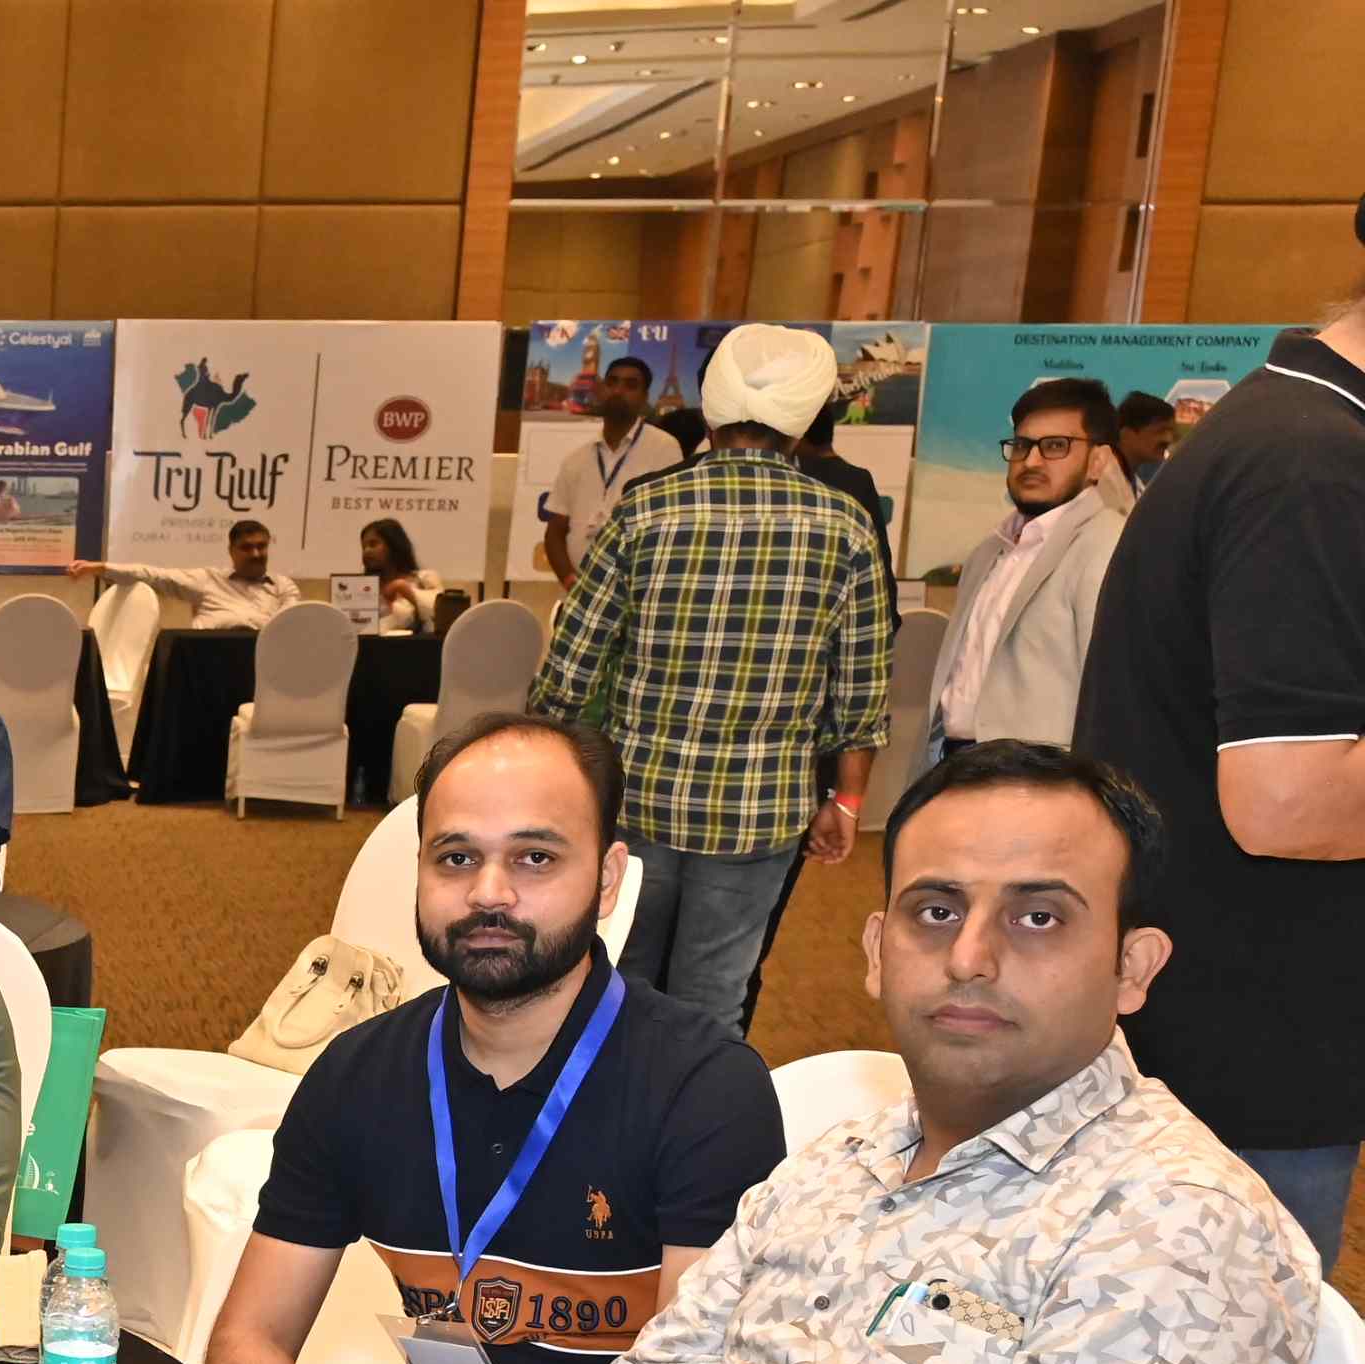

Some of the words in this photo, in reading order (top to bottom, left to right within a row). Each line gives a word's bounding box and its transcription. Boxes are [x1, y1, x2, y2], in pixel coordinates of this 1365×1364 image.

[8, 331, 73, 348] Celestyal
[1014, 334, 1097, 346] DESTINATION
[1101, 335, 1192, 348] MANAGEMENT
[1195, 336, 1261, 348] COMPANY
[382, 412, 426, 429] BWP
[54, 442, 92, 457] Gulf
[325, 445, 475, 482] PREMIER
[133, 450, 201, 512] Try
[205, 451, 290, 512] Gulf
[331, 497, 373, 510] BEST
[378, 498, 460, 512] WESTERN
[526, 1294, 628, 1332] 1890
